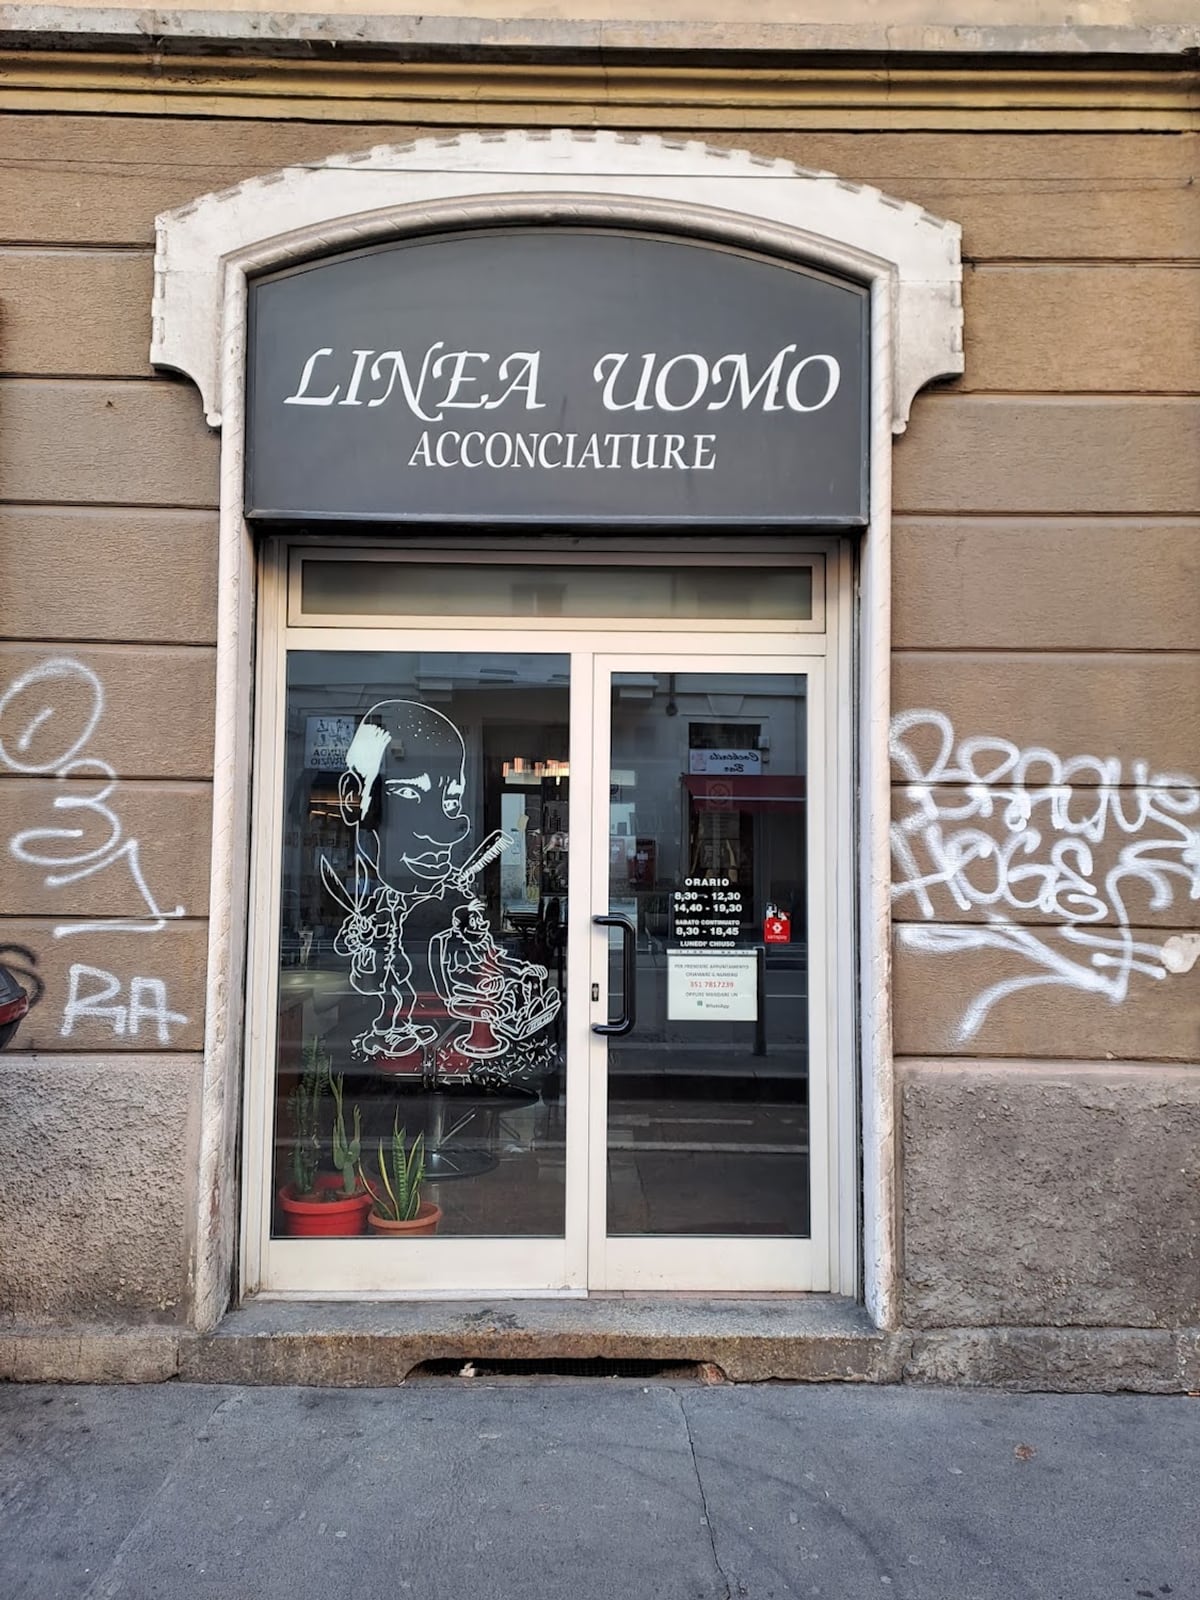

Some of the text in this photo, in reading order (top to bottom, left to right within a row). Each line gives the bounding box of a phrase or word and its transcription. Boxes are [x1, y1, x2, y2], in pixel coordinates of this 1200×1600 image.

[284, 341, 841, 422] LINEA UOMO
[408, 431, 718, 471] ACCONCIATURE
[685, 878, 729, 886] ORARIO
[674, 892, 698, 902] 8,30
[711, 892, 741, 902] 12,30
[673, 904, 703, 913] 14,40
[713, 904, 742, 914] 19,30
[676, 927, 699, 937] 8,30
[710, 927, 739, 937] 18,45
